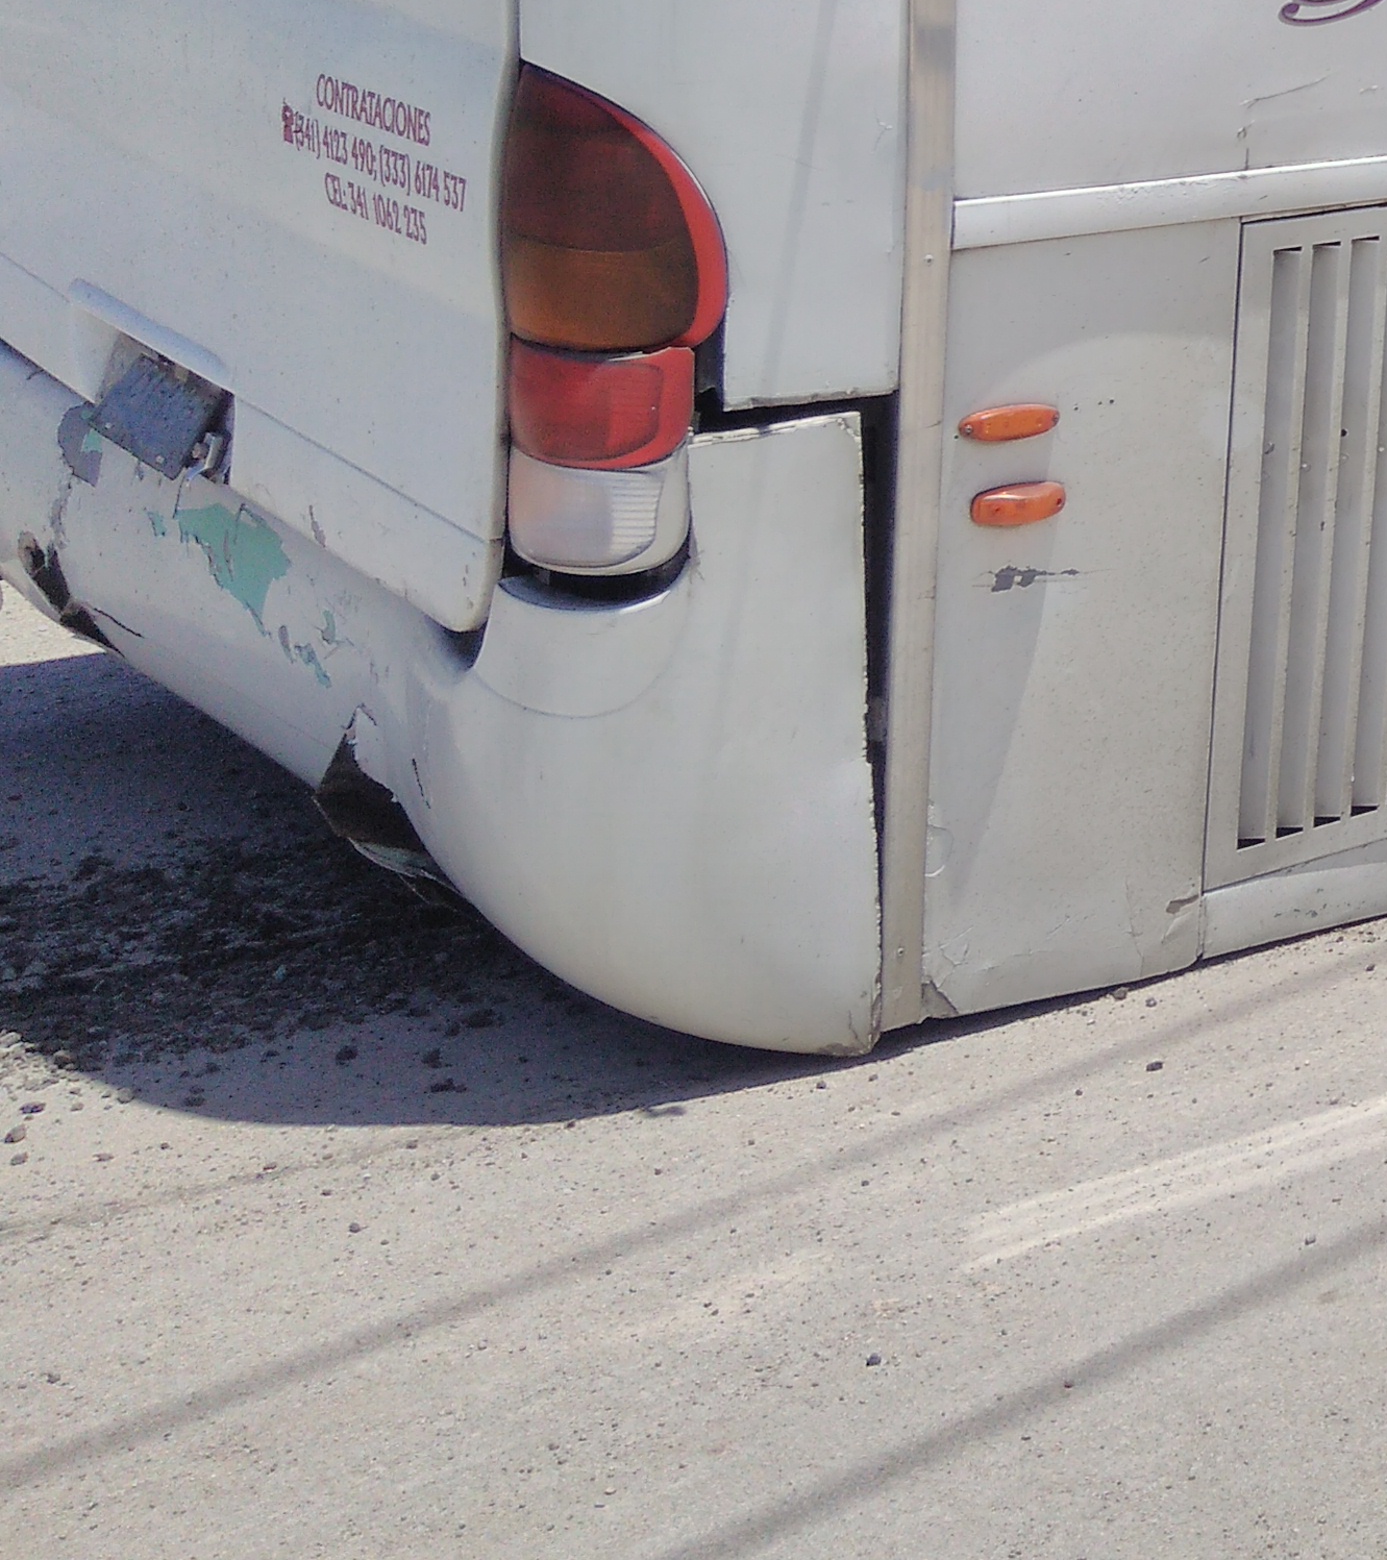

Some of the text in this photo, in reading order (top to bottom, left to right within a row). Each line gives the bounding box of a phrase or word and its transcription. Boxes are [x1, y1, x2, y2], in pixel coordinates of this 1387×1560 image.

[316, 73, 432, 146] CONTRATACIONES
[322, 126, 348, 165] 4123
[379, 144, 411, 195] (333)
[415, 160, 440, 202] 6174
[443, 170, 467, 212] 537
[347, 181, 369, 220] 341
[372, 193, 402, 234] 1062
[403, 205, 428, 245] 235
